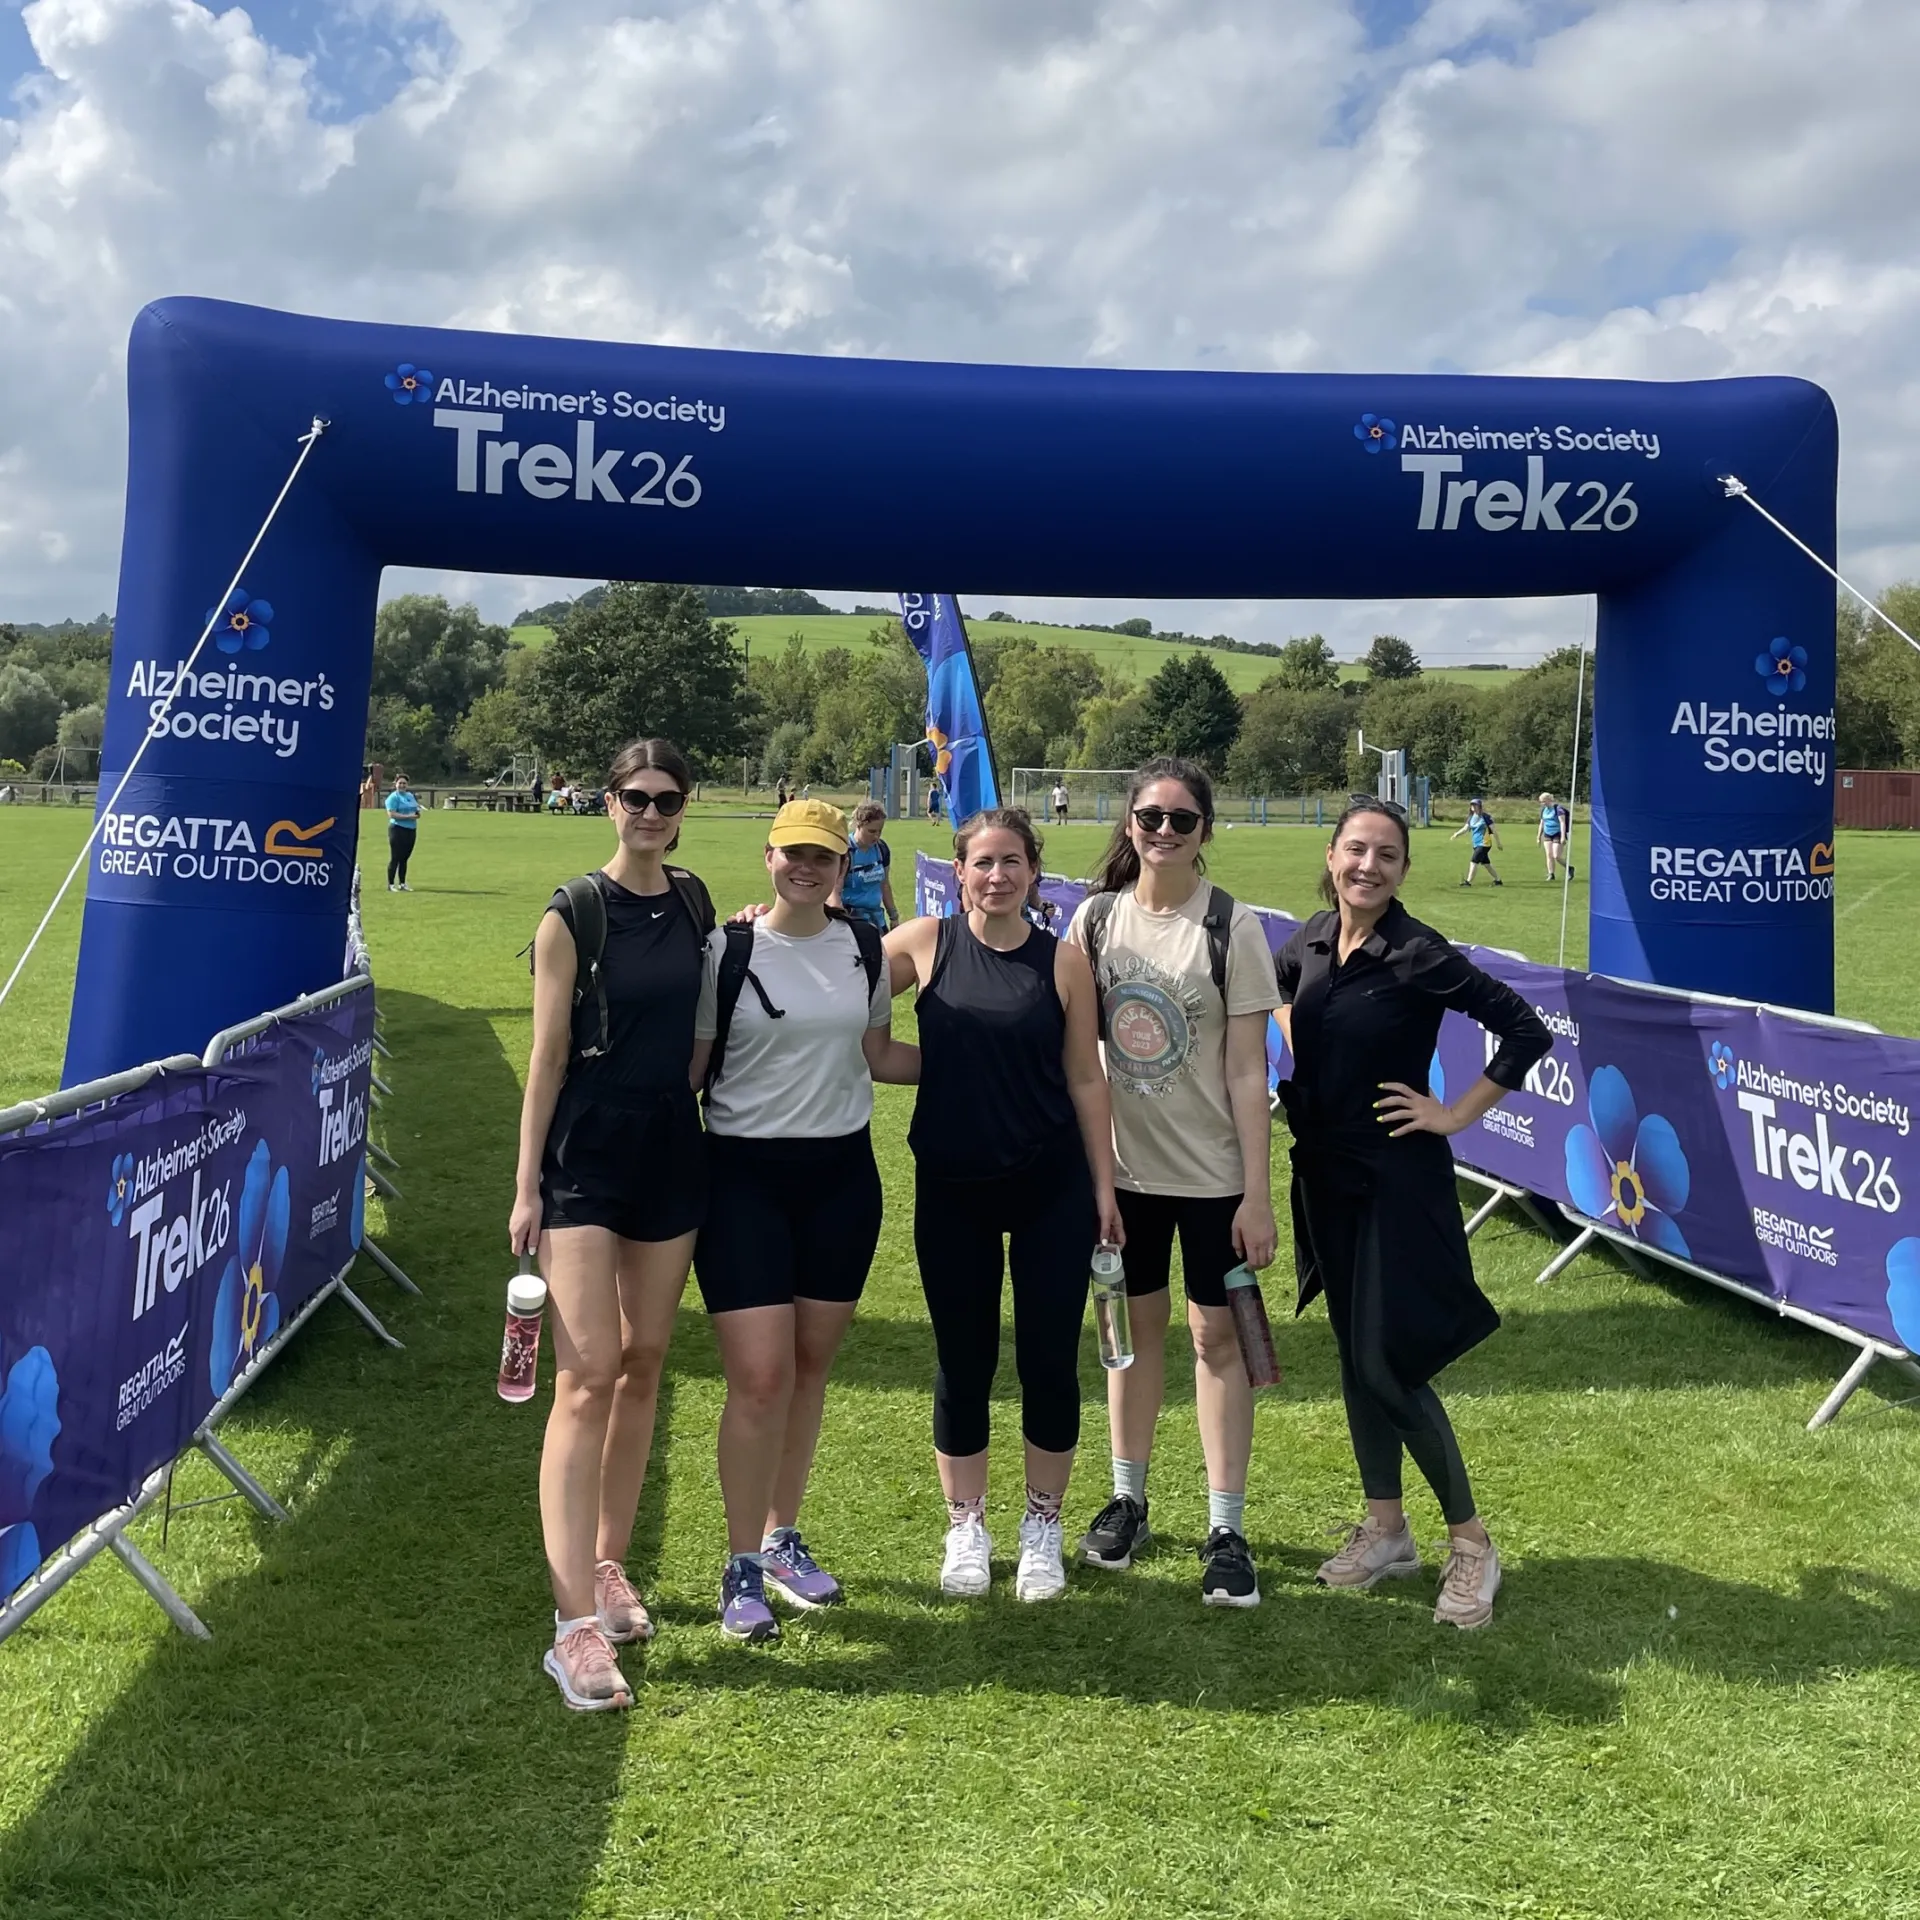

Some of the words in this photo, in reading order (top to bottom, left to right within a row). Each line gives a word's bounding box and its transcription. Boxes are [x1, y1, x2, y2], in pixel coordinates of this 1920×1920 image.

[435, 378, 607, 417] Alzheimer's
[612, 391, 726, 432] Society
[1401, 424, 1553, 451] Alzheimer's
[1555, 425, 1661, 459] Society
[127, 660, 335, 711] Alzheimer's
[147, 699, 300, 758] Society
[1670, 702, 1836, 741] Alzheimer's
[1704, 737, 1826, 786] Society
[102, 814, 257, 853] REGATTA
[100, 849, 168, 878] GREAT
[173, 853, 331, 886] OUTDOORS
[1650, 847, 1806, 877] REGATTA
[1650, 878, 1736, 902] GREAT
[1736, 1059, 1833, 1111] Alzheimer's
[1833, 1083, 1910, 1136] Society
[1482, 1118, 1501, 1134] GREAT
[1501, 1125, 1535, 1148] OUTDOORS
[132, 1125, 208, 1203] Alzheimer's
[206, 1107, 247, 1155] Society
[1753, 1206, 1808, 1243] REGATTA
[1755, 1226, 1784, 1248] GREAT
[1785, 1238, 1838, 1267] OUTDOORS
[116, 1396, 141, 1431] GREAT
[141, 1356, 186, 1410] OUTDOORS
[118, 1351, 164, 1410] REGATTA
